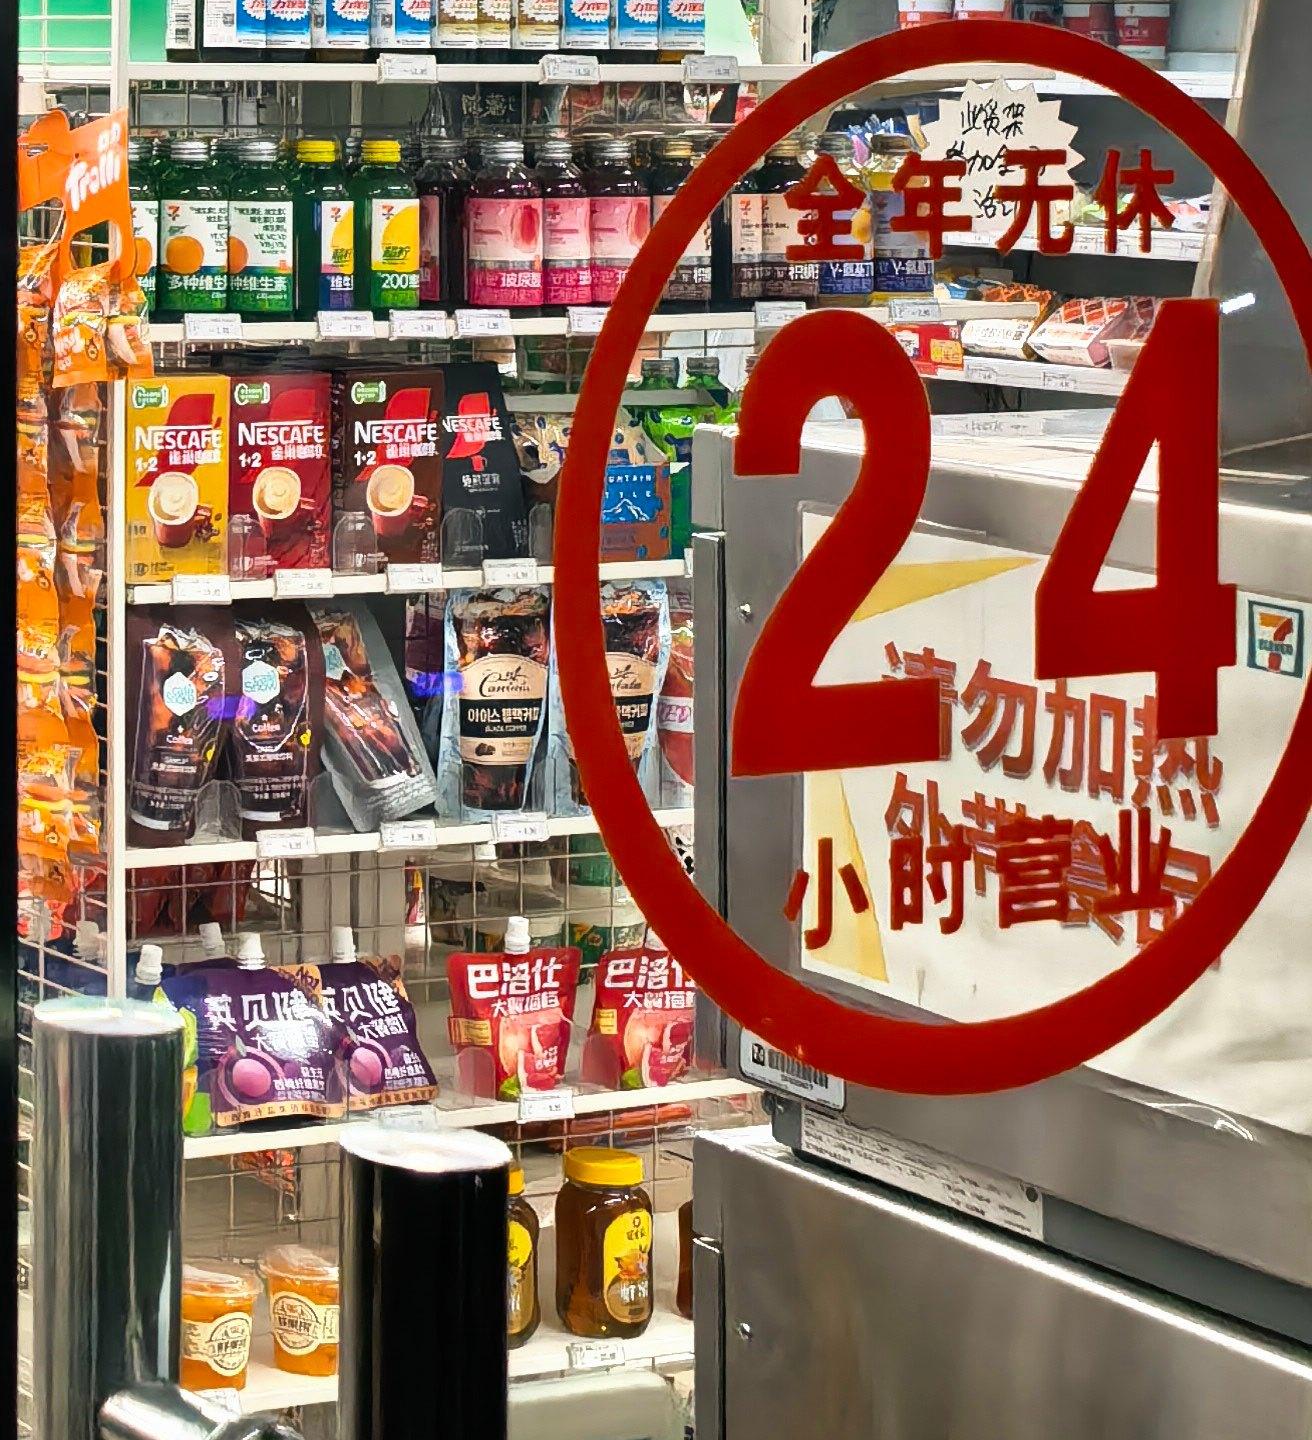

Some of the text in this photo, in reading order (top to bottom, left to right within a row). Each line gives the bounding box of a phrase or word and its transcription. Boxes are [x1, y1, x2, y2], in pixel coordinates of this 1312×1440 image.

[782, 148, 1177, 261] 全年无休
[731, 297, 1237, 779] 24
[783, 805, 1175, 951] 小时营业
